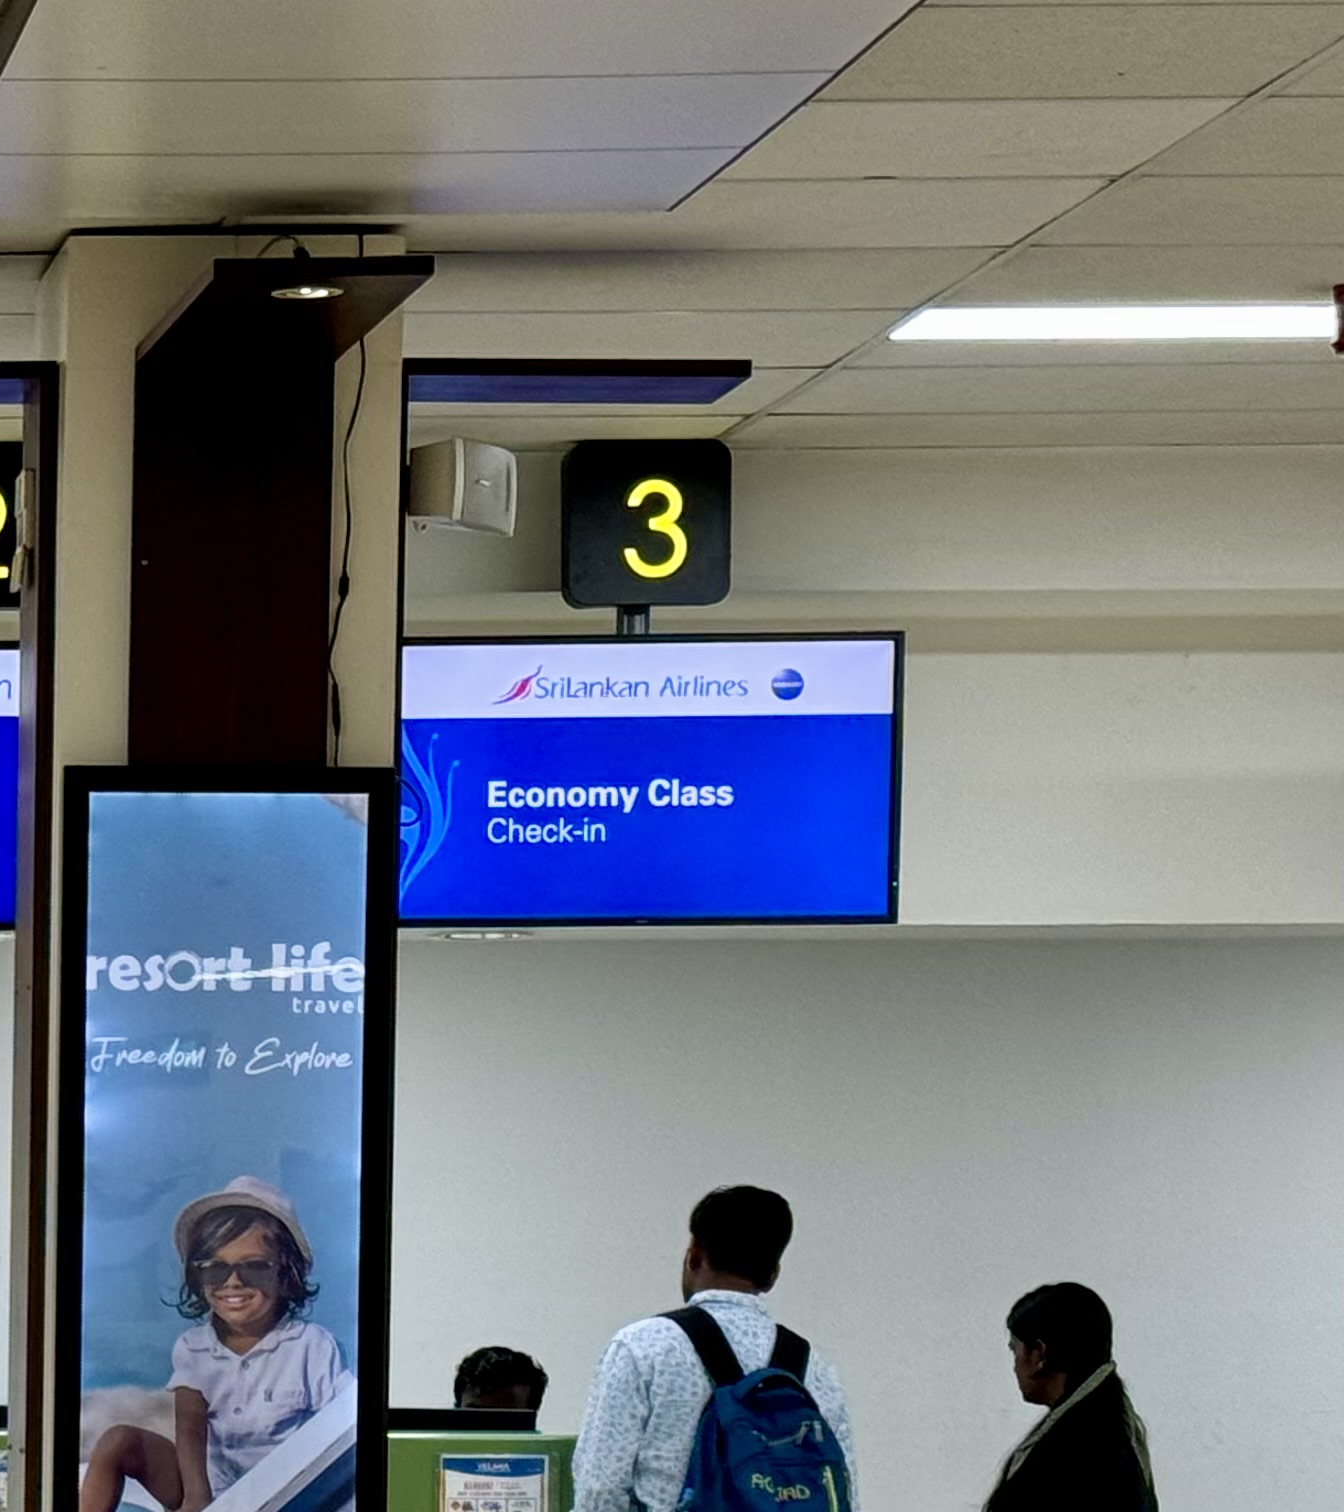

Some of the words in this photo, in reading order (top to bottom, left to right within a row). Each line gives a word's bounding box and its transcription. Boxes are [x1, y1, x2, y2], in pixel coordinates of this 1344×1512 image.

[623, 479, 689, 579] 3
[533, 676, 651, 700] SriLankan
[659, 675, 749, 699] Airlines
[486, 781, 638, 814] Economy
[647, 779, 735, 808] Class
[486, 817, 607, 844] Check-in
[86, 947, 253, 992] resort
[271, 941, 365, 993] life
[90, 1036, 208, 1074] Freedom
[216, 1042, 238, 1070] to
[244, 1037, 354, 1076] Explore
